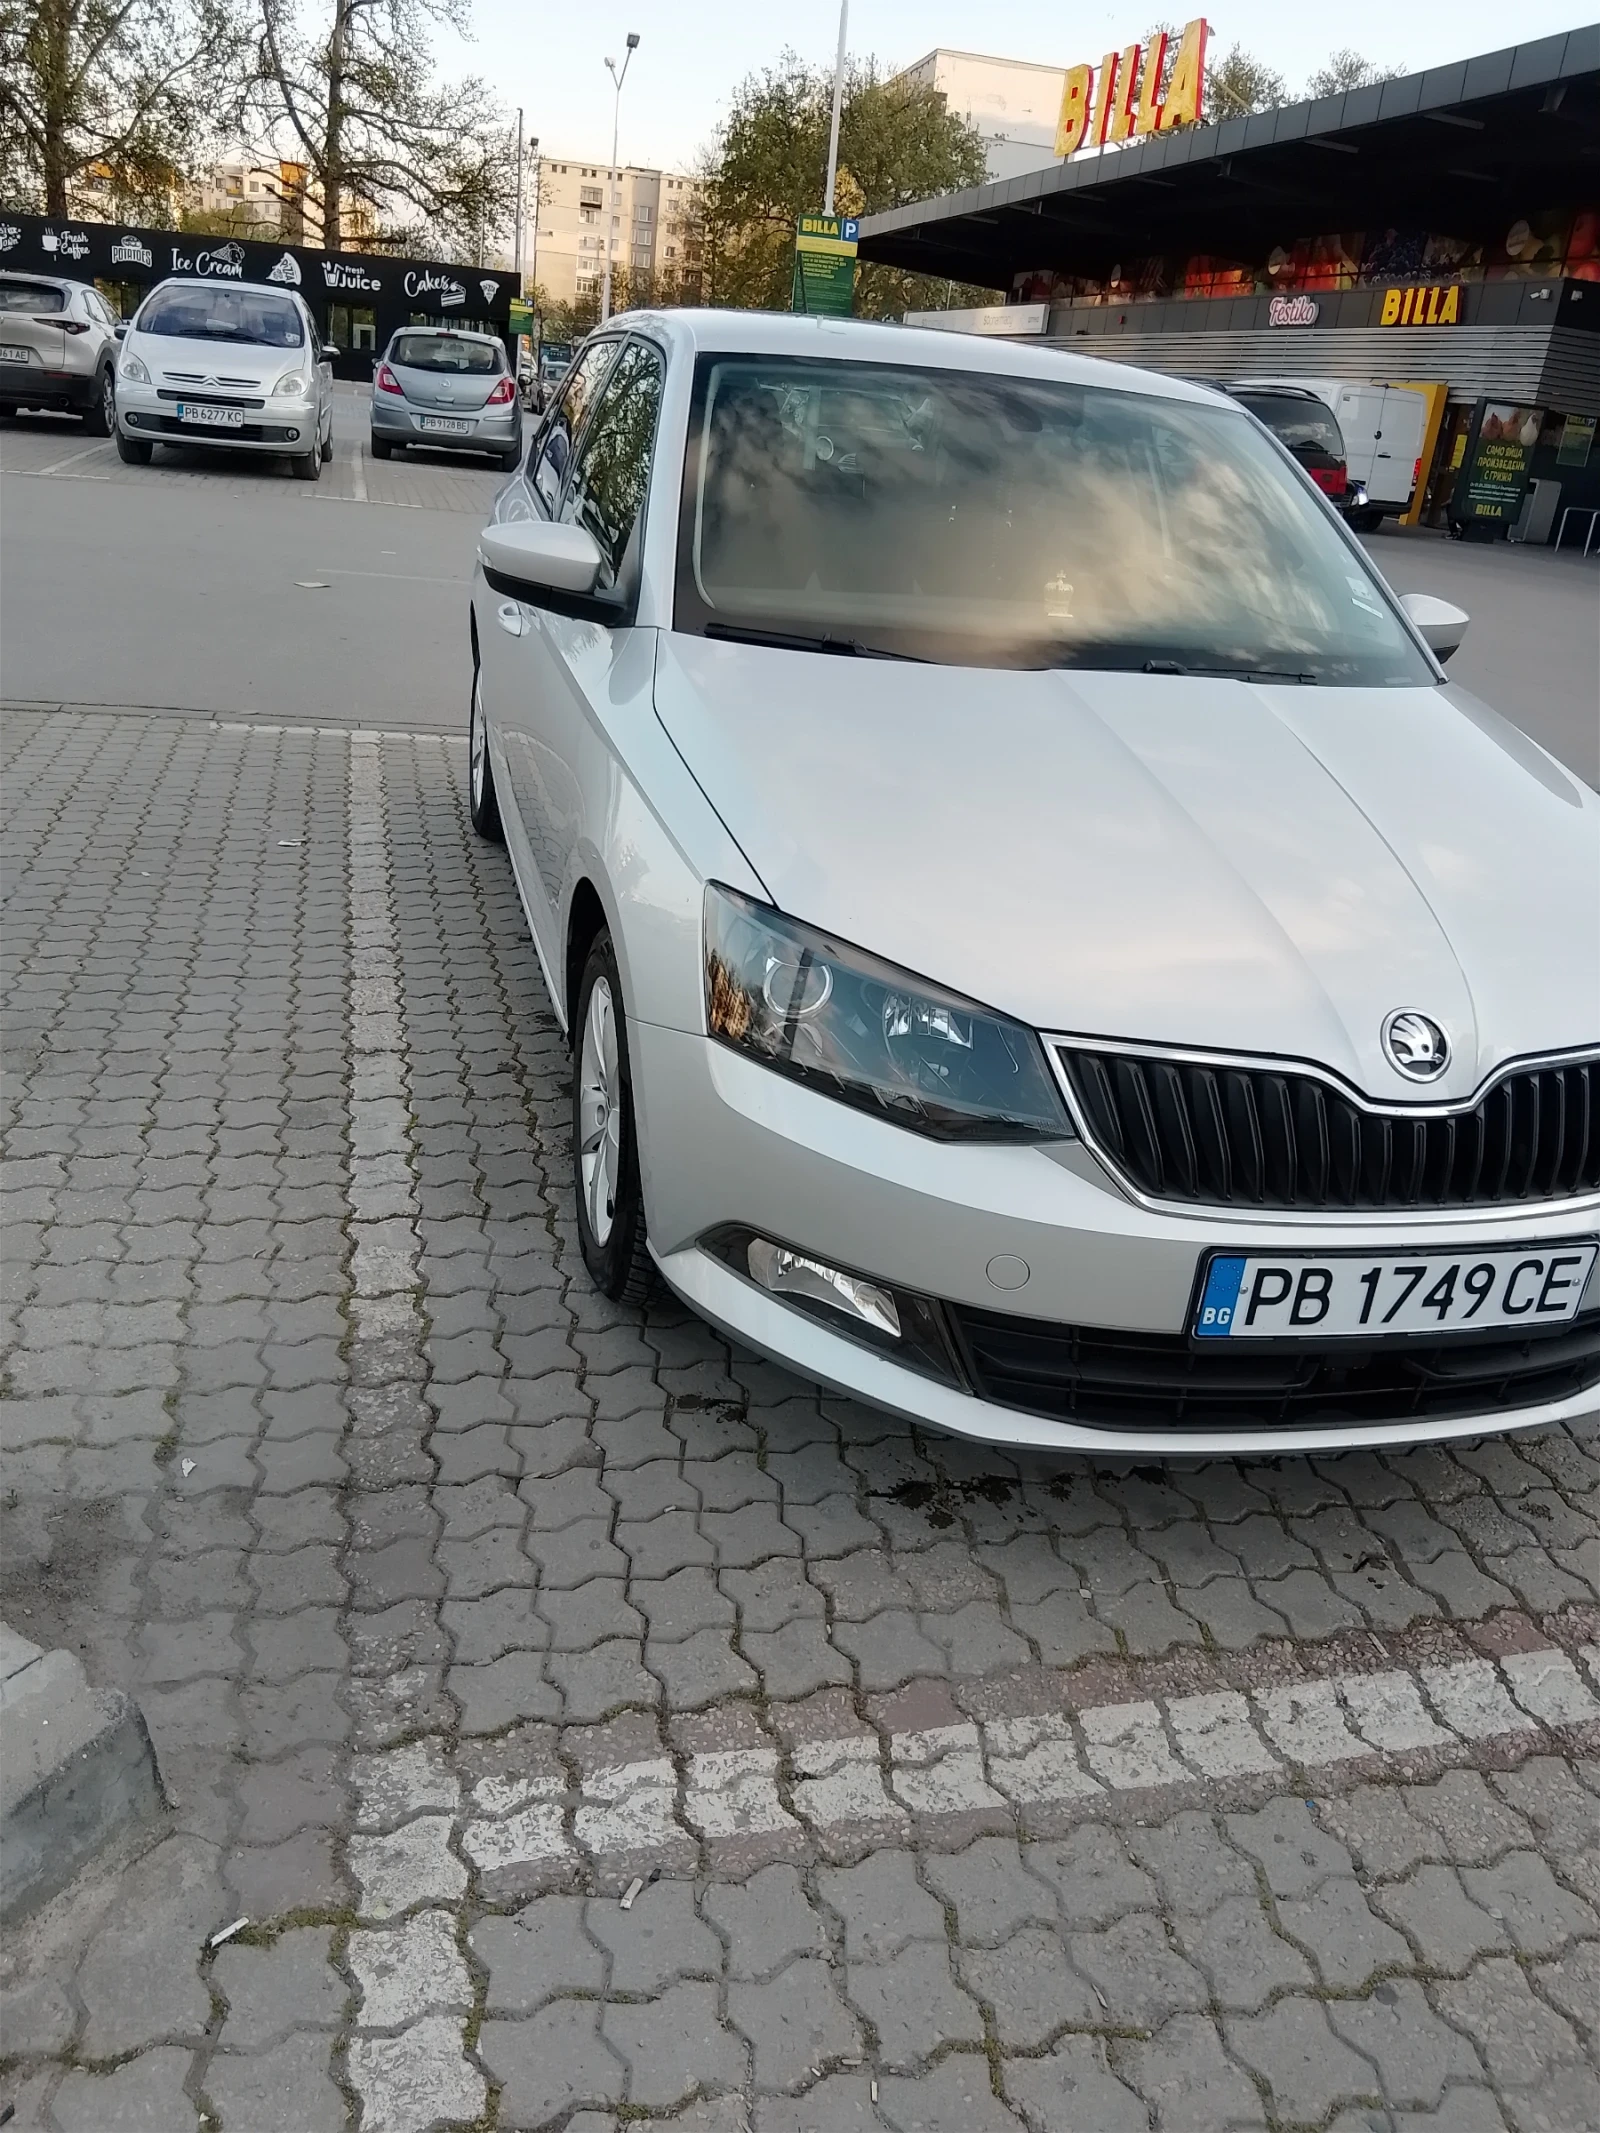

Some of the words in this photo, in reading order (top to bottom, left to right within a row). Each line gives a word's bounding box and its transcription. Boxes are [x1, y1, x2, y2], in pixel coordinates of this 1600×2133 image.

[1054, 18, 1207, 157] BILLA
[61, 231, 89, 243] Fresh
[802, 218, 839, 235] BILLA
[845, 222, 857, 239] P
[60, 242, 90, 260] Coffee
[111, 245, 153, 268] POTATOES
[171, 248, 194, 271] Ice
[196, 251, 243, 279] Cream
[280, 258, 296, 281] PIZZA
[345, 265, 366, 275] Fresh
[339, 274, 382, 291] Juice
[404, 269, 451, 298] Cakes
[1269, 295, 1319, 327] Festiko
[1380, 286, 1463, 326] BILLA
[15, 351, 27, 360] AE
[185, 407, 199, 419] PB
[200, 408, 226, 421] 6277
[227, 411, 242, 423] KC
[426, 418, 437, 427] PB
[437, 419, 456, 429] 9128
[1486, 445, 1505, 456] САМО
[1477, 457, 1526, 471] ПРОИЗВЕДЕНИ
[1490, 471, 1513, 482] ГРИЖА
[1475, 504, 1502, 516] BILLA
[1244, 1267, 1334, 1327] PB
[1358, 1262, 1497, 1325] 1749
[1501, 1255, 1583, 1316] CE
[1202, 1306, 1231, 1326] BG
